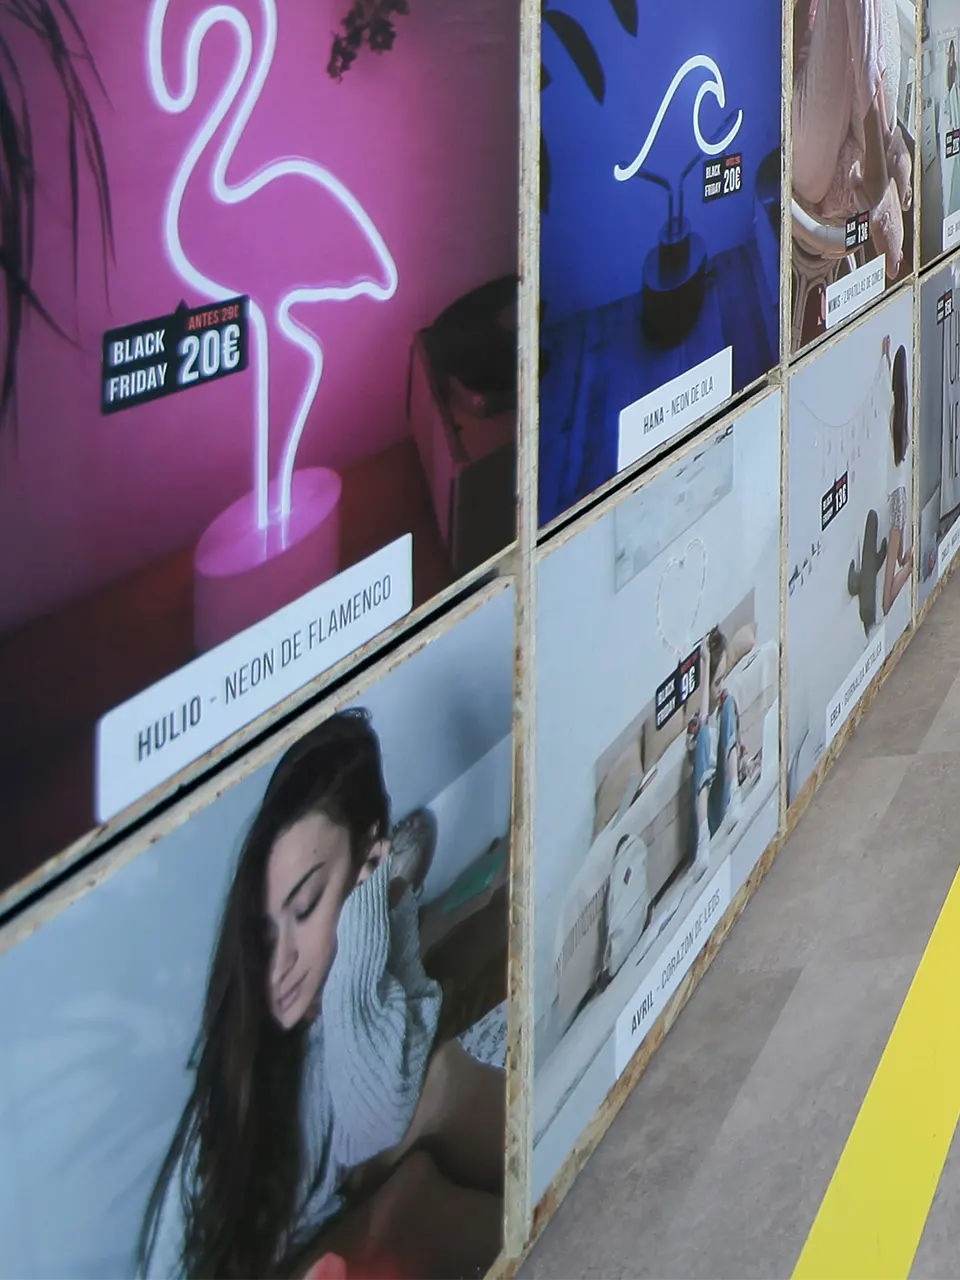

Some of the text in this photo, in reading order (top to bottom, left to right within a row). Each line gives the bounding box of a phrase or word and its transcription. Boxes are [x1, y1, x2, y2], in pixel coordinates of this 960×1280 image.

[706, 164, 721, 179] BLACK
[724, 165, 741, 193] 20€
[704, 181, 721, 197] FRIDAY
[858, 222, 868, 243] 13€
[188, 309, 218, 331] ANTES
[112, 329, 166, 366] BLACK
[180, 323, 241, 384] 20€
[109, 362, 168, 402] FRIDAY
[643, 406, 664, 434] HANA
[671, 390, 690, 417] NEON
[690, 384, 700, 405] DE
[701, 376, 714, 398] OLA
[836, 483, 847, 511] 13€
[137, 696, 201, 762] HULIO
[224, 648, 275, 705] NEON
[281, 630, 302, 668] DE
[308, 574, 392, 650] FLAMENCO
[681, 665, 696, 700] 9€
[658, 678, 675, 706] BLACK
[631, 990, 655, 1035] AVRIL
[703, 889, 722, 925] LEDS
